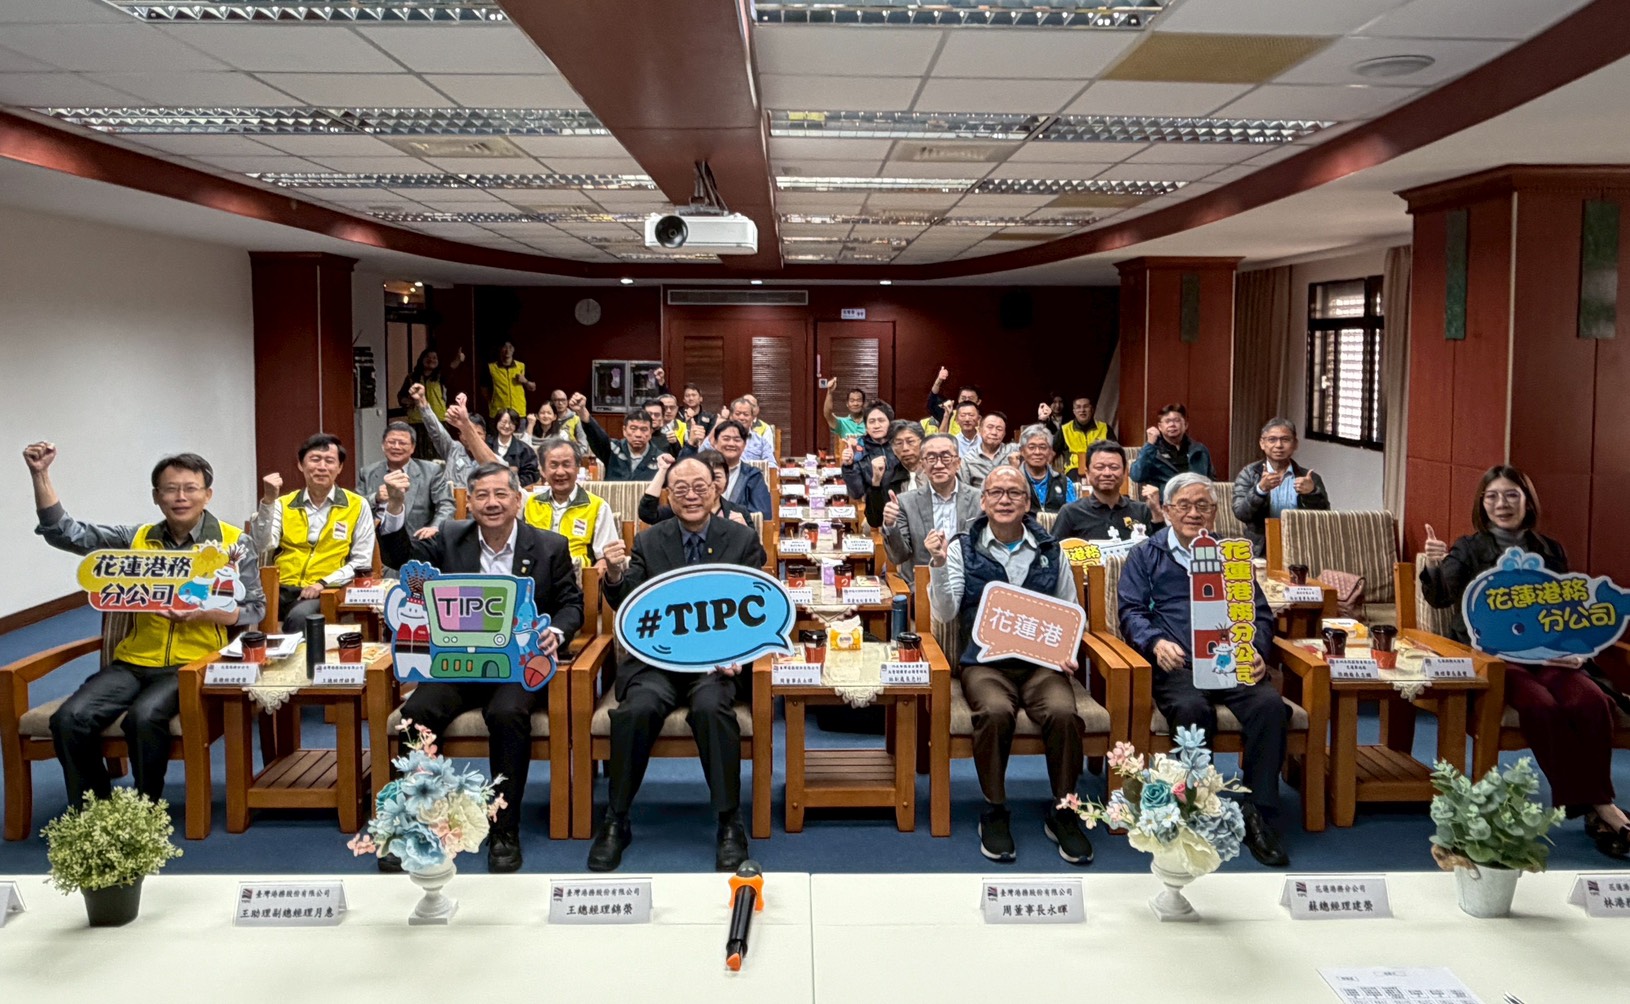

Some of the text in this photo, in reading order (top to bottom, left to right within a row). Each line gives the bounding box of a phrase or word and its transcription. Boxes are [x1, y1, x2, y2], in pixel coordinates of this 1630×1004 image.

[93, 554, 192, 577] 花蓮港務
[100, 583, 175, 606] 分公司
[437, 597, 504, 616] TIPC
[1486, 578, 1589, 610] 花蓮港務
[636, 595, 767, 639] #TIPC
[989, 606, 1063, 648] 花蓮港
[1220, 540, 1256, 684] 花蓮港務分公司
[1537, 602, 1616, 632] 分公司
